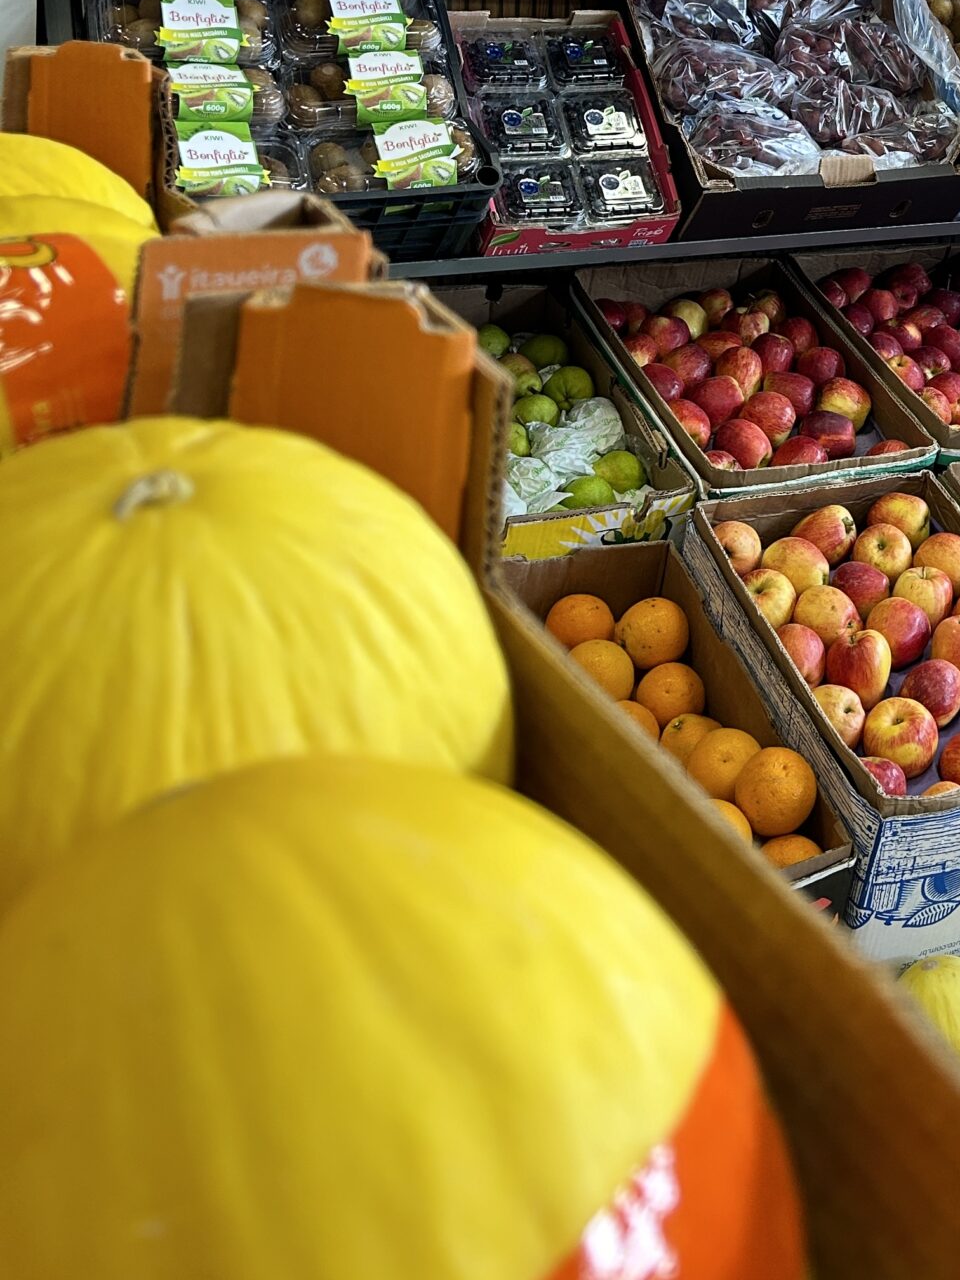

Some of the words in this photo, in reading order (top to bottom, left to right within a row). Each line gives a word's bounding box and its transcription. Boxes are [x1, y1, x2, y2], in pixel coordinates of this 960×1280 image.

[336, 0, 390, 13] Bonfiglio
[169, 10, 227, 26] Bonfiglio
[356, 62, 412, 75] Bonfiglio
[205, 104, 226, 114] 600g
[382, 103, 401, 111] 600g
[399, 122, 418, 131] KIWI
[383, 132, 441, 152] Bonfiglio
[187, 148, 246, 164] Bonfiglio
